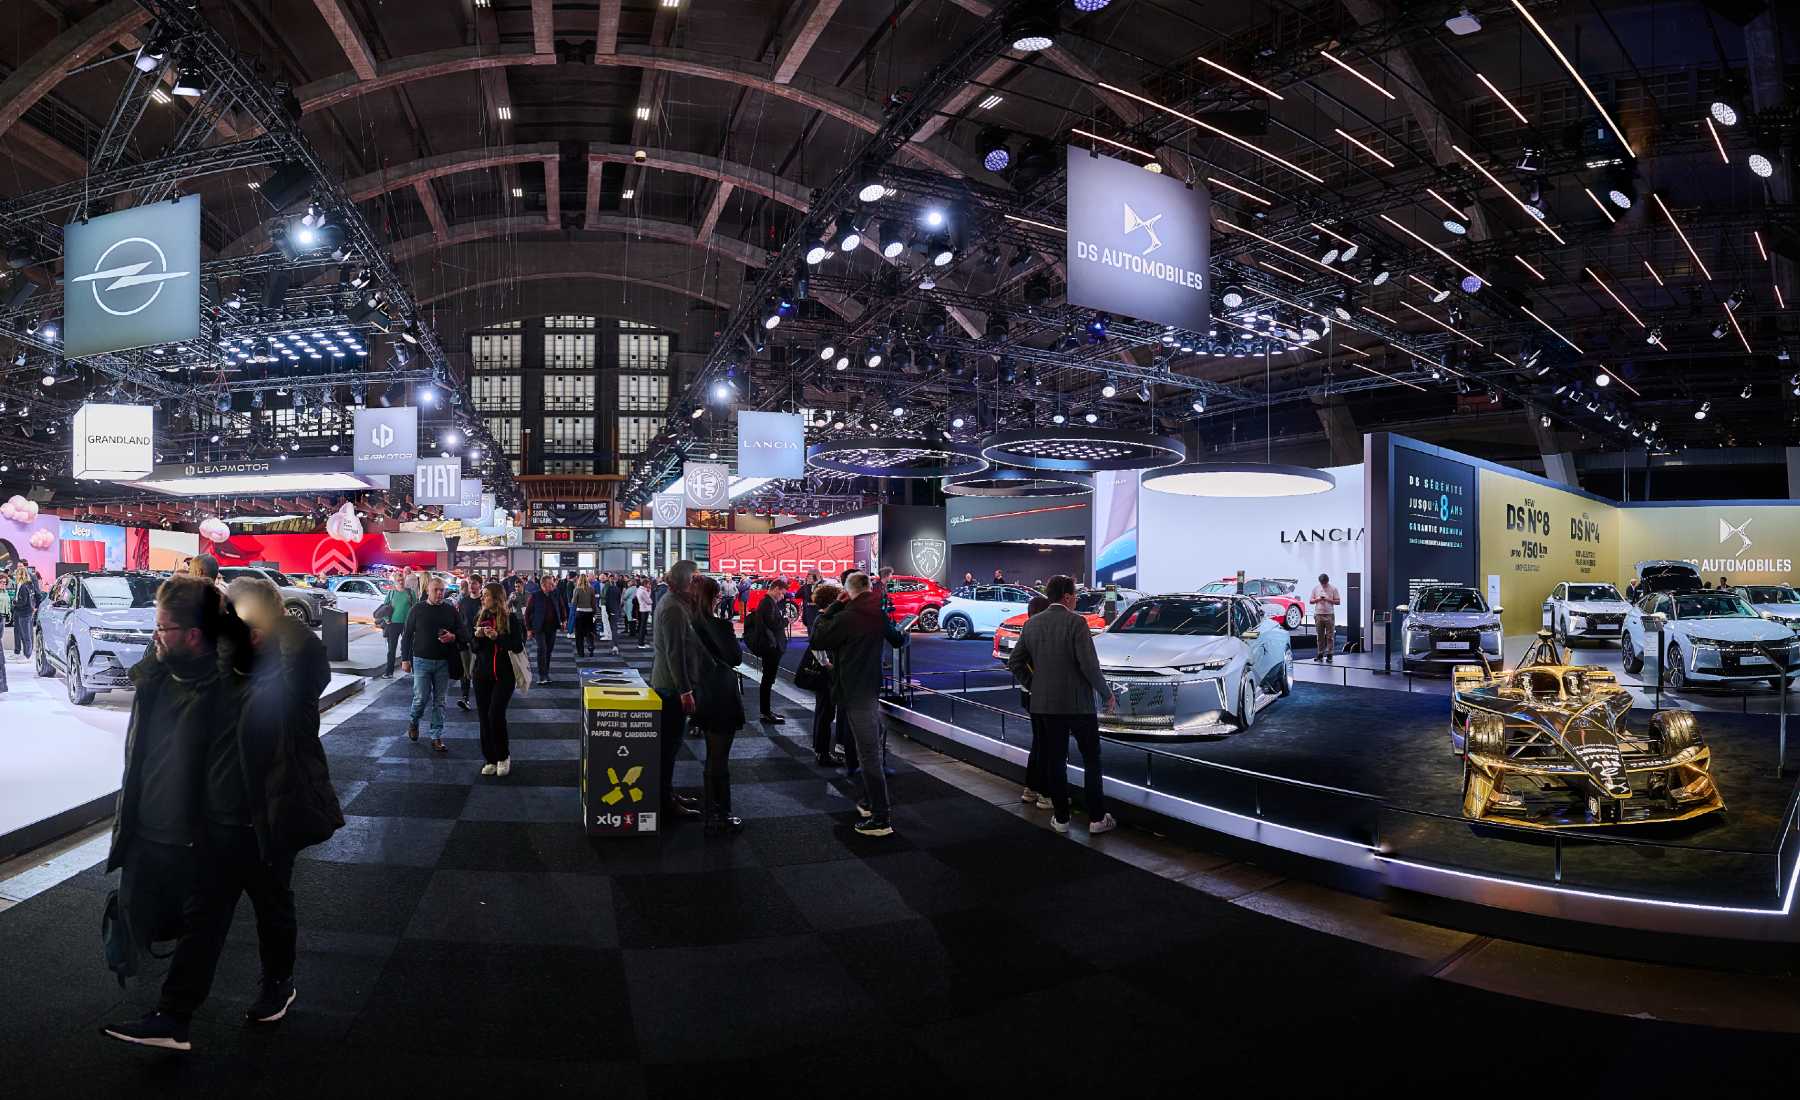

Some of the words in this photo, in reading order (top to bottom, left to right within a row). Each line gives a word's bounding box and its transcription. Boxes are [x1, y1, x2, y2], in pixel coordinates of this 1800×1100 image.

[1077, 240, 1098, 262] DS
[1101, 246, 1203, 290] AUTOMOBILES
[88, 435, 151, 446] GRANDLAND
[743, 440, 798, 450] LANCIA
[197, 463, 269, 474] LEAPMOTOR
[416, 464, 459, 498] FIAT
[1440, 494, 1449, 522] 8
[1524, 498, 1535, 507] NEW
[1506, 503, 1525, 533] DS
[71, 524, 91, 537] Jeep
[1570, 517, 1584, 540] DS
[1521, 540, 1538, 559] 750
[719, 559, 854, 573] PEUGEOT
[1701, 559, 1792, 572] AUTOMOBILES
[596, 813, 622, 828] xlg
